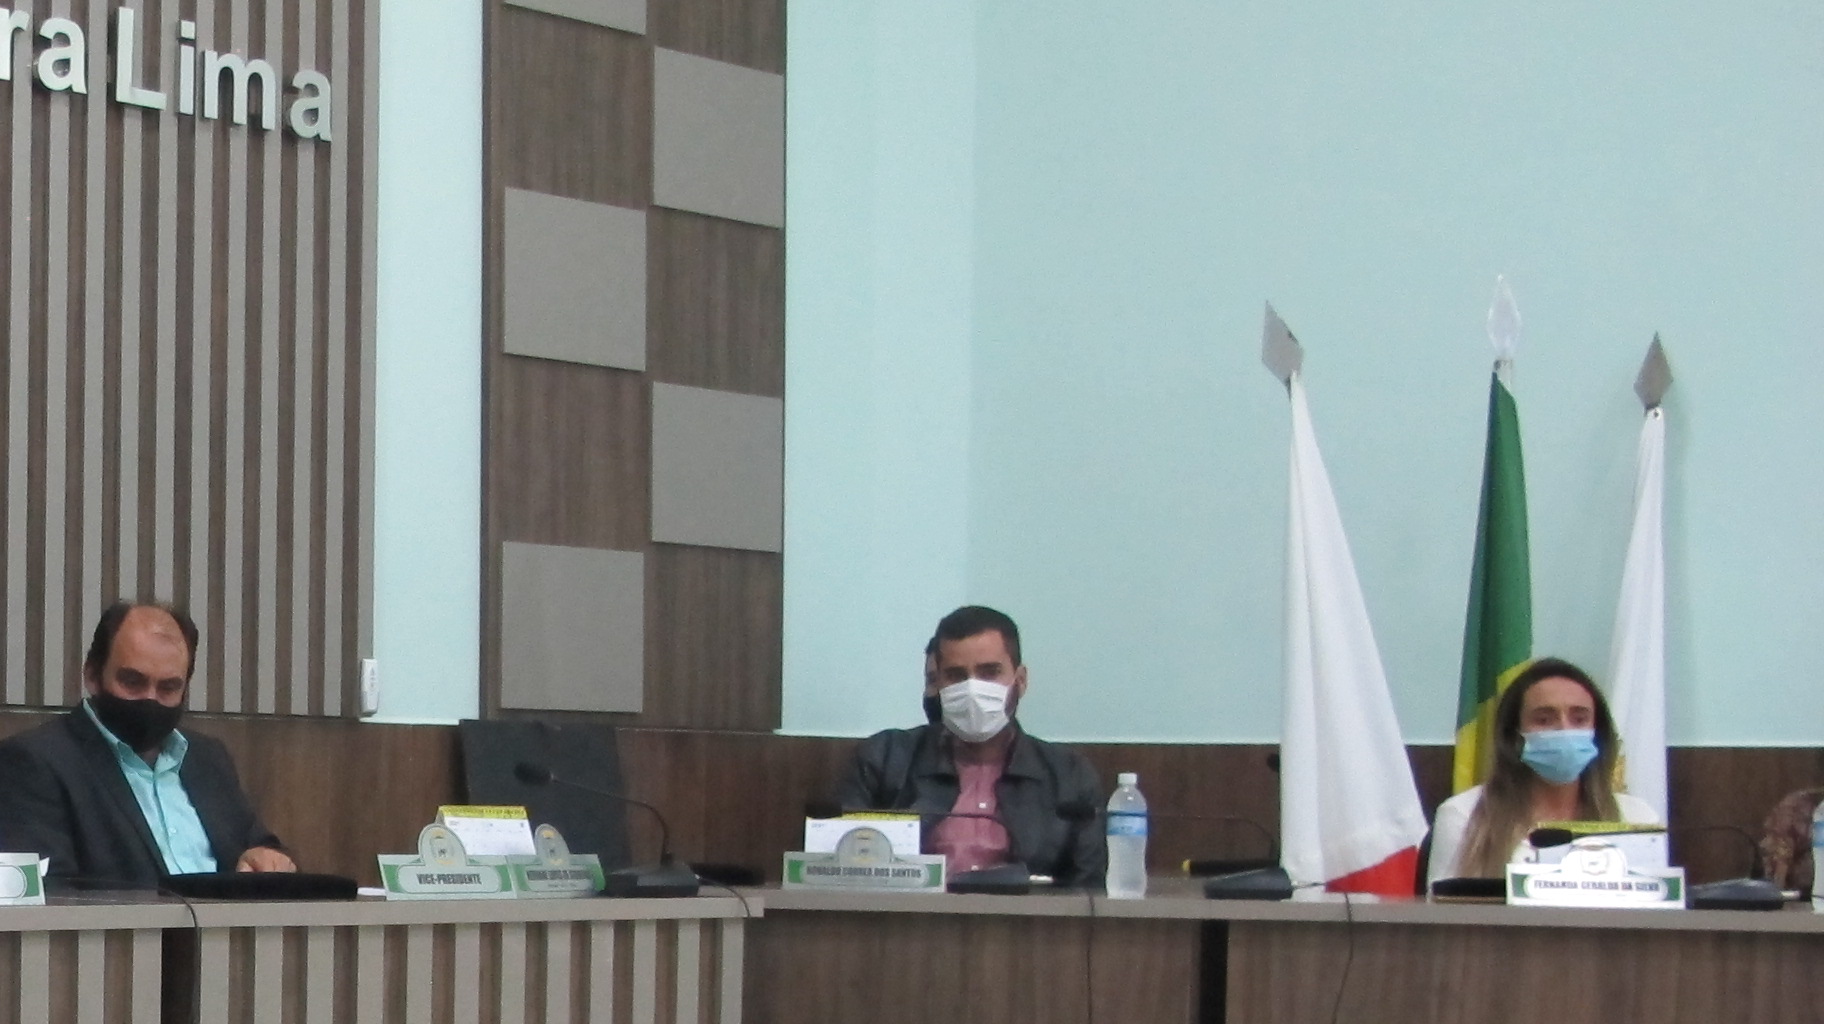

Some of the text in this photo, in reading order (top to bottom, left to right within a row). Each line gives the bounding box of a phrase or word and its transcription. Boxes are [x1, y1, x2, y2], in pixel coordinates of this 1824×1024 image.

[114, 6, 333, 142] Lima
[891, 867, 922, 878] SANTOS
[416, 873, 482, 885] VICE-PRESIDENTE
[1534, 879, 1578, 890] FERNANDA
